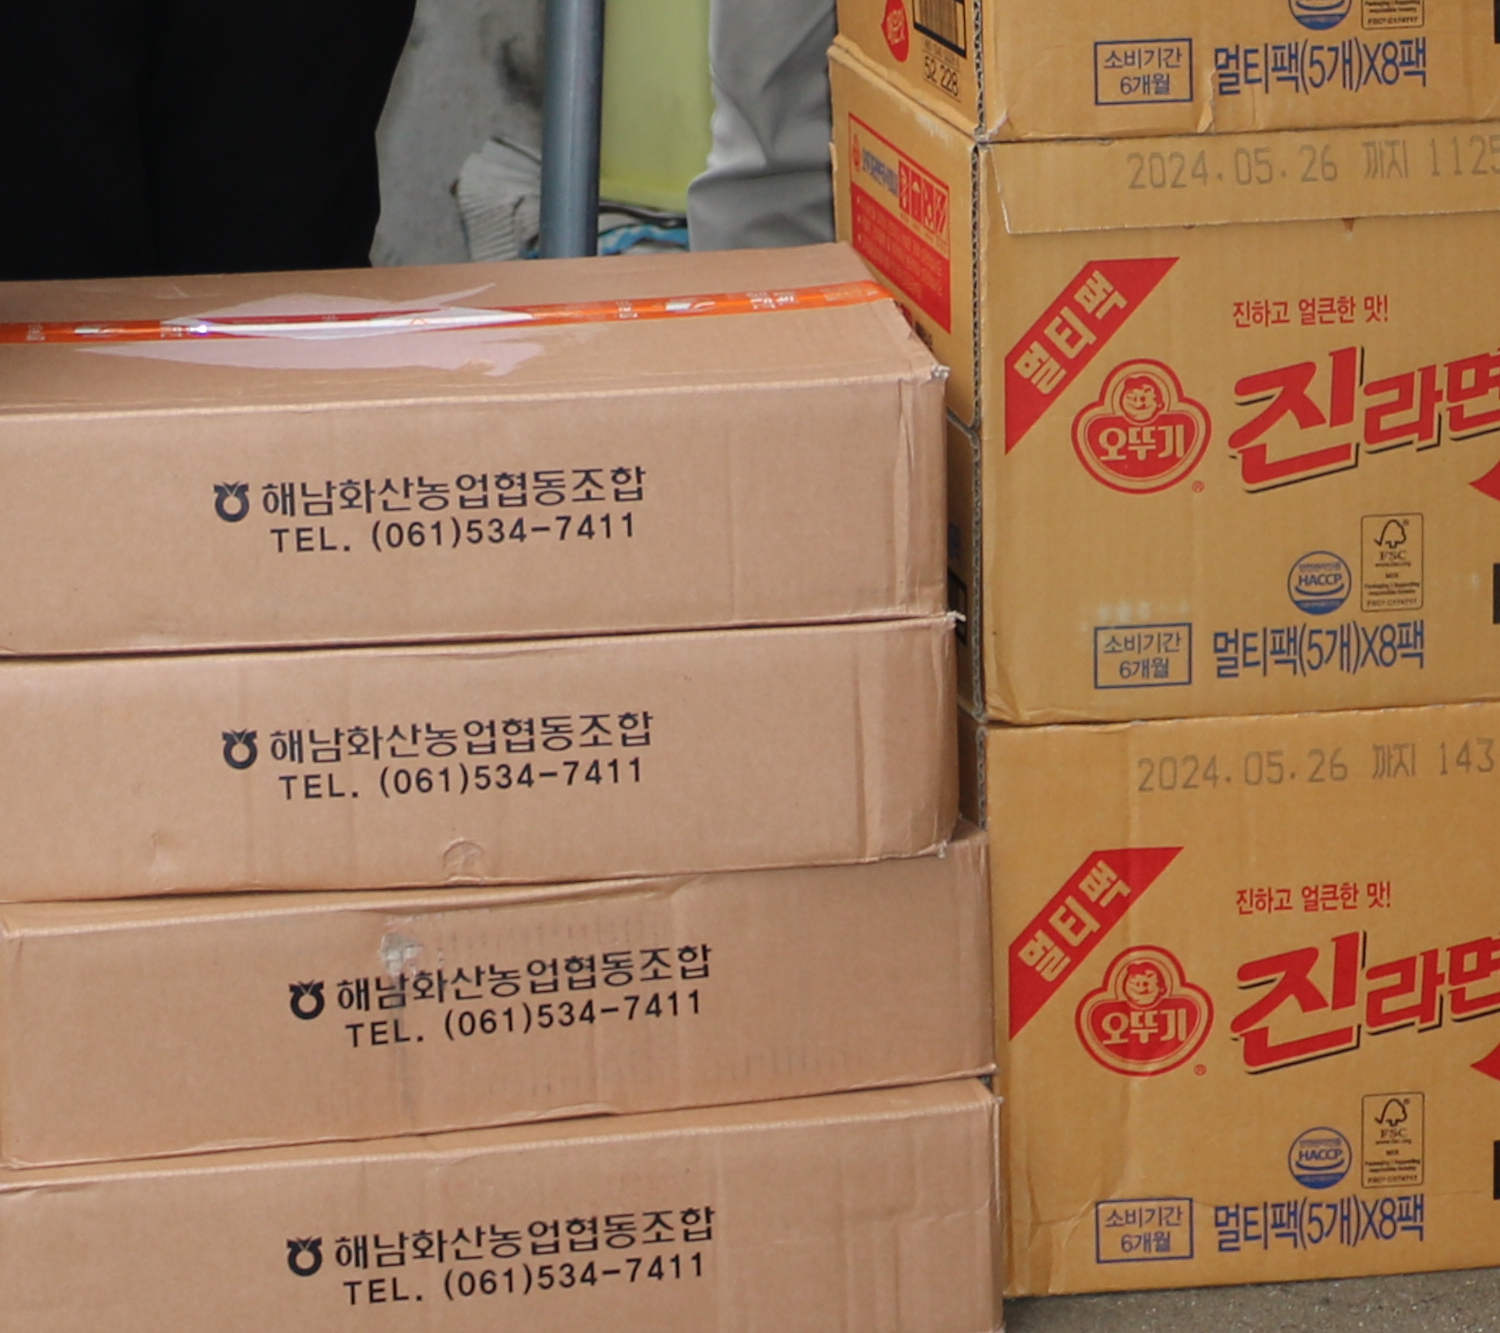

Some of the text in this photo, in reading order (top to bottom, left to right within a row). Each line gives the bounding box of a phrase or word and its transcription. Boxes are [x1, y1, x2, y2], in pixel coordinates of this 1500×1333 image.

[1104, 47, 1182, 70] 소비기간
[1214, 36, 1426, 96] 멀티팩(5개)X8팩
[1120, 73, 1170, 96] 6개월
[1127, 144, 1338, 190] 2024.05.26
[1015, 271, 1127, 393] 멀티팩
[1234, 295, 1387, 328] 진하고 얼큰한 맛!
[1098, 424, 1186, 464] 오뚜기
[261, 465, 648, 518] 해남화산농업협동조합
[269, 511, 634, 554] TEL. (061)534-7411
[1297, 571, 1341, 585] HACCP
[1103, 632, 1181, 655] 소비기간
[1213, 618, 1424, 679] 멀티팩(5개)X8팩
[1119, 657, 1169, 680] 6개월
[269, 710, 655, 765] 해남화산농업협동조합
[277, 756, 642, 801] TEL. (061)534-7411
[1138, 749, 1349, 792] 2024.05.26
[1236, 881, 1390, 915] 진하고 얼큰한 맛!
[1020, 861, 1131, 980] 멀티팩
[335, 942, 714, 1013] 해남화산농업협동조합
[344, 988, 701, 1049] TEL. (061)534-7411
[1101, 1008, 1189, 1047] 오뚜기
[1298, 1148, 1342, 1163] HACCP
[334, 1204, 718, 1271] 해남화산농업협동조합
[1106, 1208, 1183, 1231] 소비기간
[1215, 1193, 1424, 1254] 멀티팩(5개)X8팩
[1122, 1233, 1171, 1255] 6개월
[342, 1250, 704, 1307] TEL. (061)534-7411
